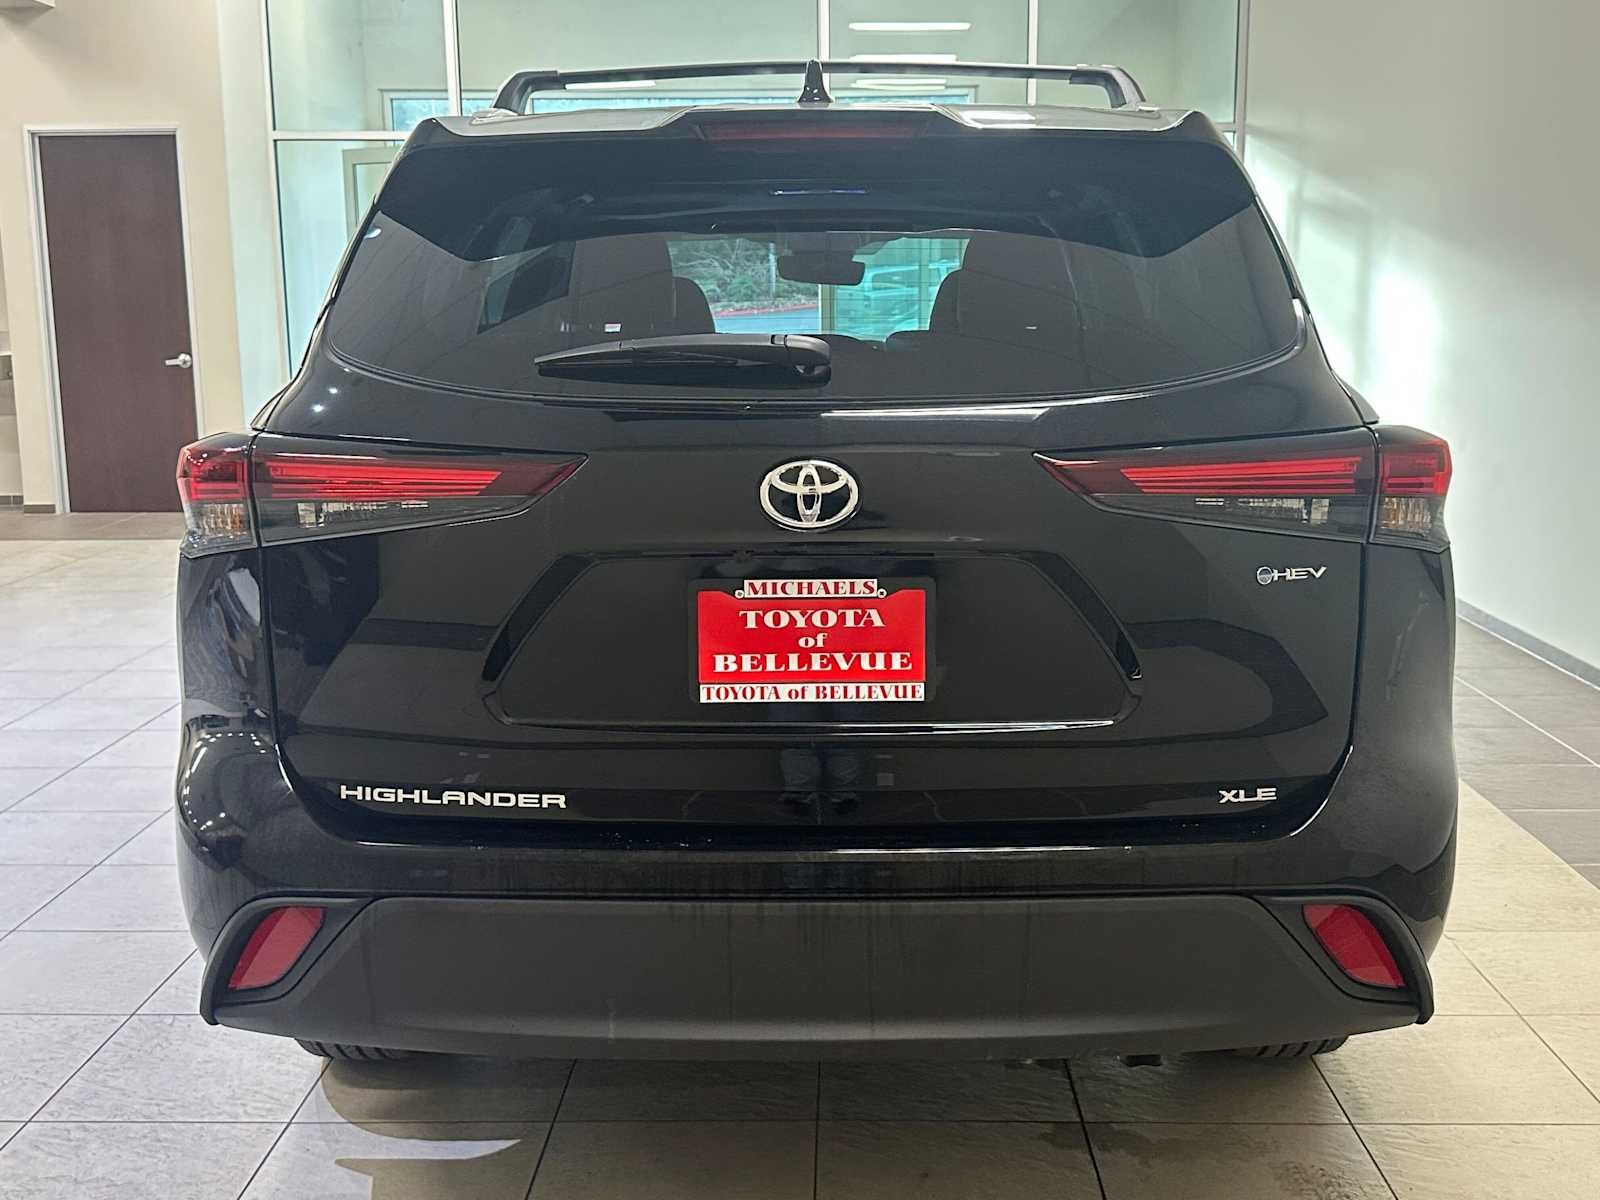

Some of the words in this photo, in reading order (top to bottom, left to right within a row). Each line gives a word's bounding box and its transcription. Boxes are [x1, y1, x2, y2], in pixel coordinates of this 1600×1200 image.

[748, 580, 876, 596] MICHAELS
[739, 608, 885, 629] TOYOTA
[798, 632, 828, 648] of
[712, 651, 913, 673] BELLEVUE
[702, 685, 781, 701] TOYOTA
[788, 685, 809, 700] of
[815, 684, 923, 700] BELLEVUE
[339, 784, 567, 809] HIGHLANDER
[1218, 787, 1278, 804] XLE
